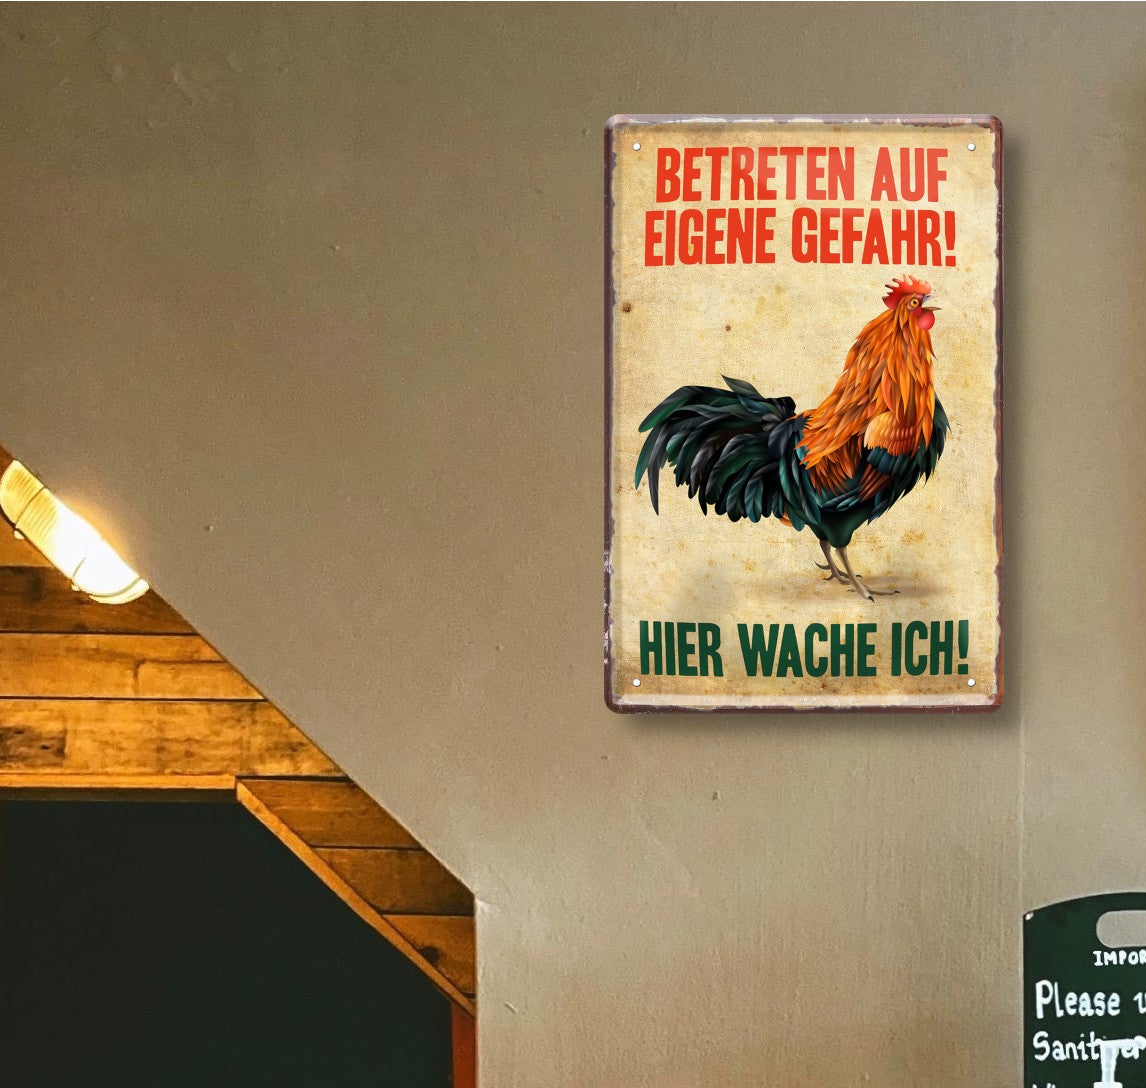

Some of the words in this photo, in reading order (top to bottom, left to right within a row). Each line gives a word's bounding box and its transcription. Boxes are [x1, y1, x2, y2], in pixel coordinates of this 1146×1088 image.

[655, 146, 855, 203] BETRETEN
[871, 146, 949, 203] AUF
[644, 207, 777, 267] EIGENE
[791, 207, 957, 267] GEFAHR!
[639, 620, 723, 677] HIER
[737, 622, 877, 677] WACHE
[891, 620, 970, 676] ICH!
[1035, 979, 1121, 1020] Please
